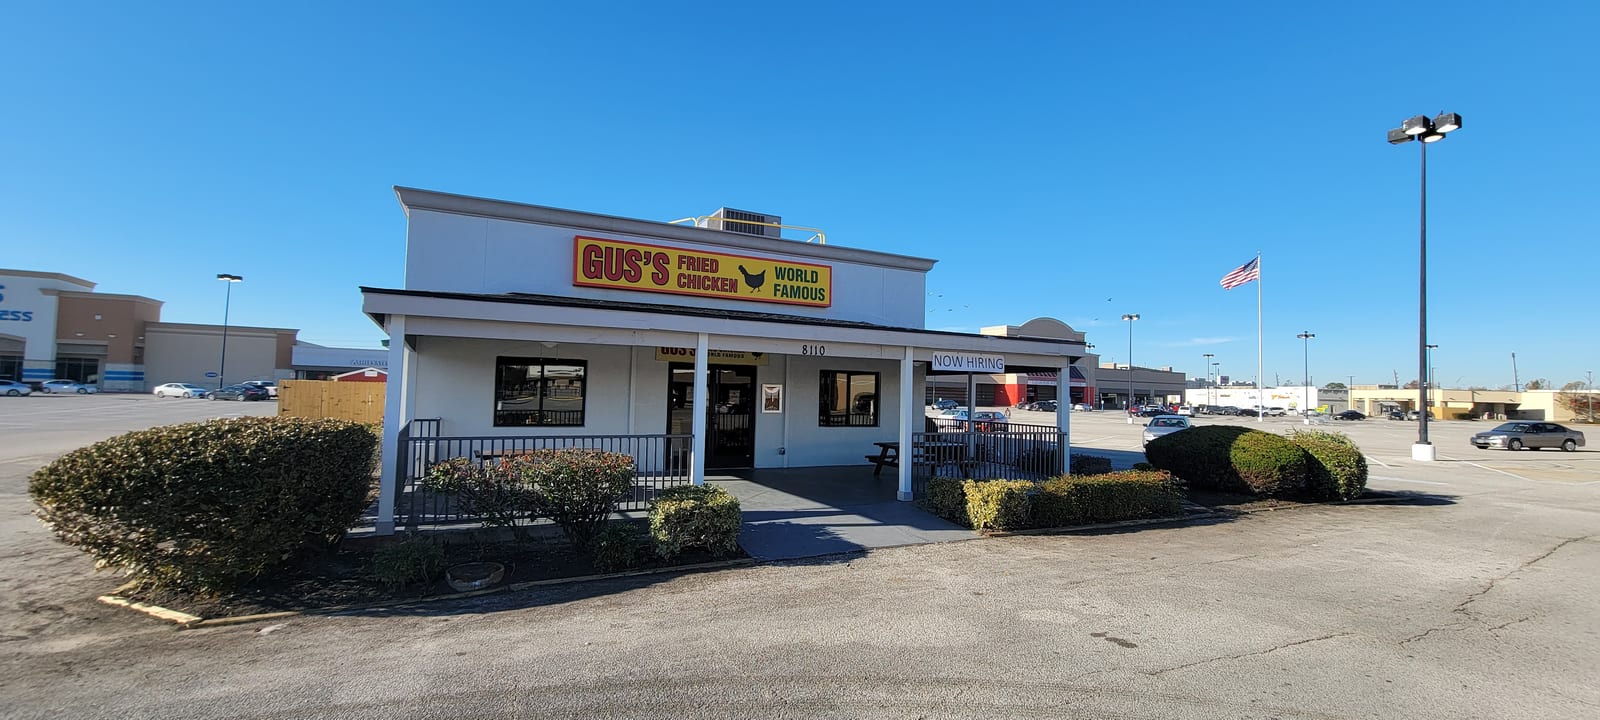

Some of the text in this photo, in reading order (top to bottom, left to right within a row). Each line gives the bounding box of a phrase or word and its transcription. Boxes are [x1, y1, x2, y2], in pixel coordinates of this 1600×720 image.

[582, 244, 670, 286] GUS'S
[677, 254, 719, 274] FRIED
[676, 272, 738, 293] CHICKEN
[774, 266, 818, 284] WORLD
[773, 283, 826, 301] FAMOUS
[802, 344, 825, 356] 8110
[934, 354, 1004, 370] NOW HIRING
